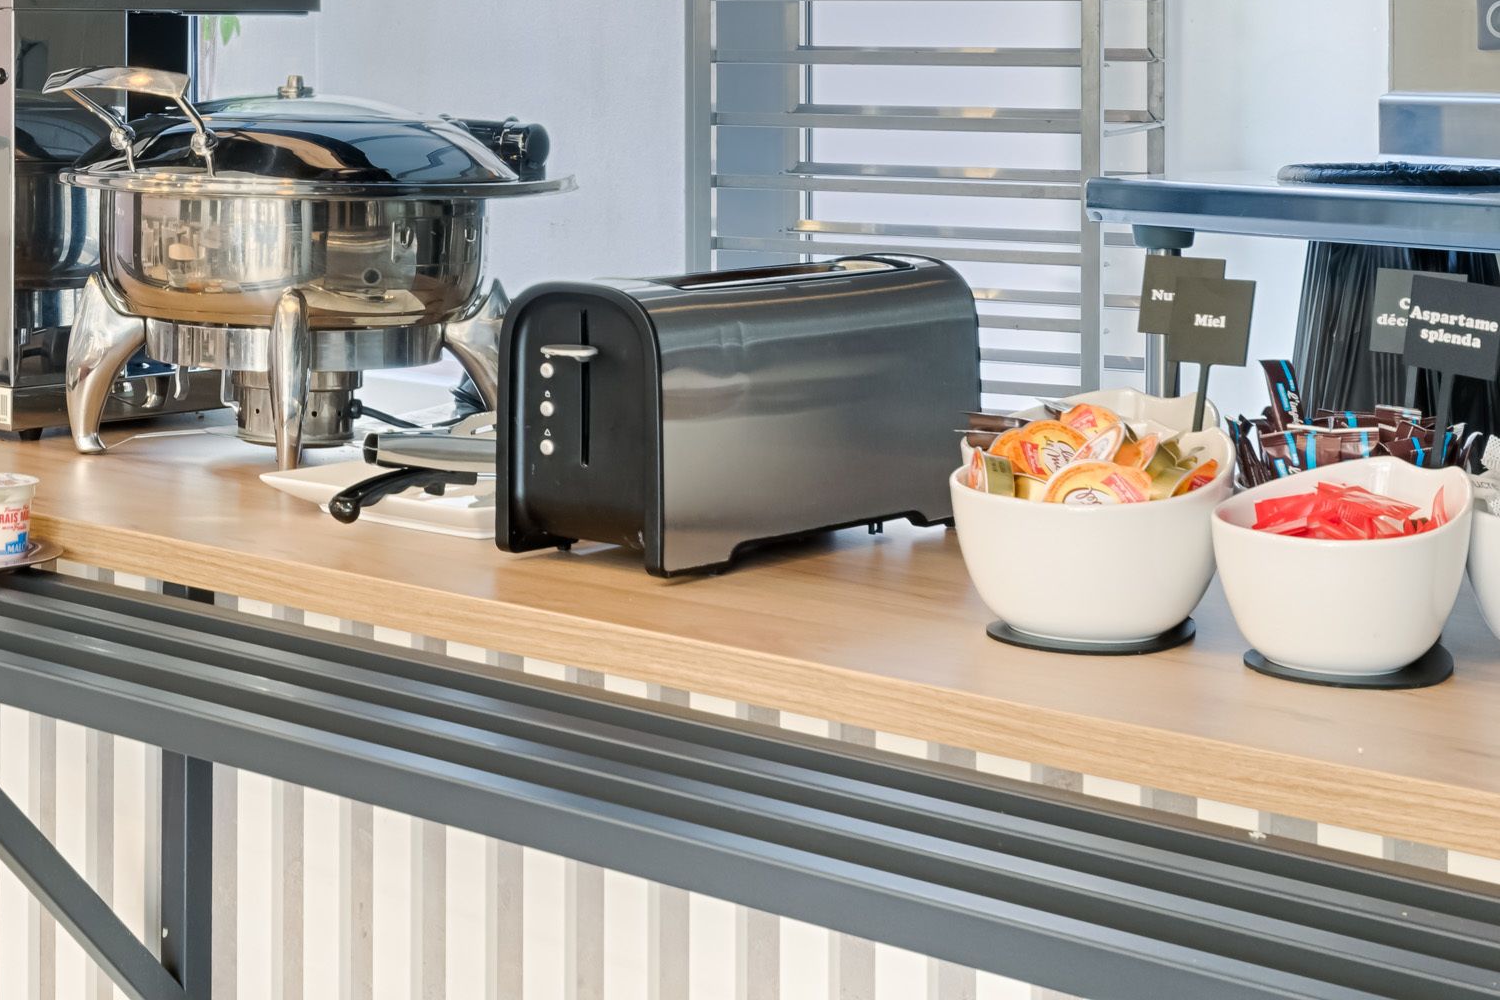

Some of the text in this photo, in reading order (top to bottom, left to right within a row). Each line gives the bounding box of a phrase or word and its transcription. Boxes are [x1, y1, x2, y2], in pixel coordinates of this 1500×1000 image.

[1151, 288, 1176, 301] Nu
[1193, 313, 1226, 328] Miel
[1409, 305, 1499, 333] Aspartame
[1420, 328, 1482, 349] splenda
